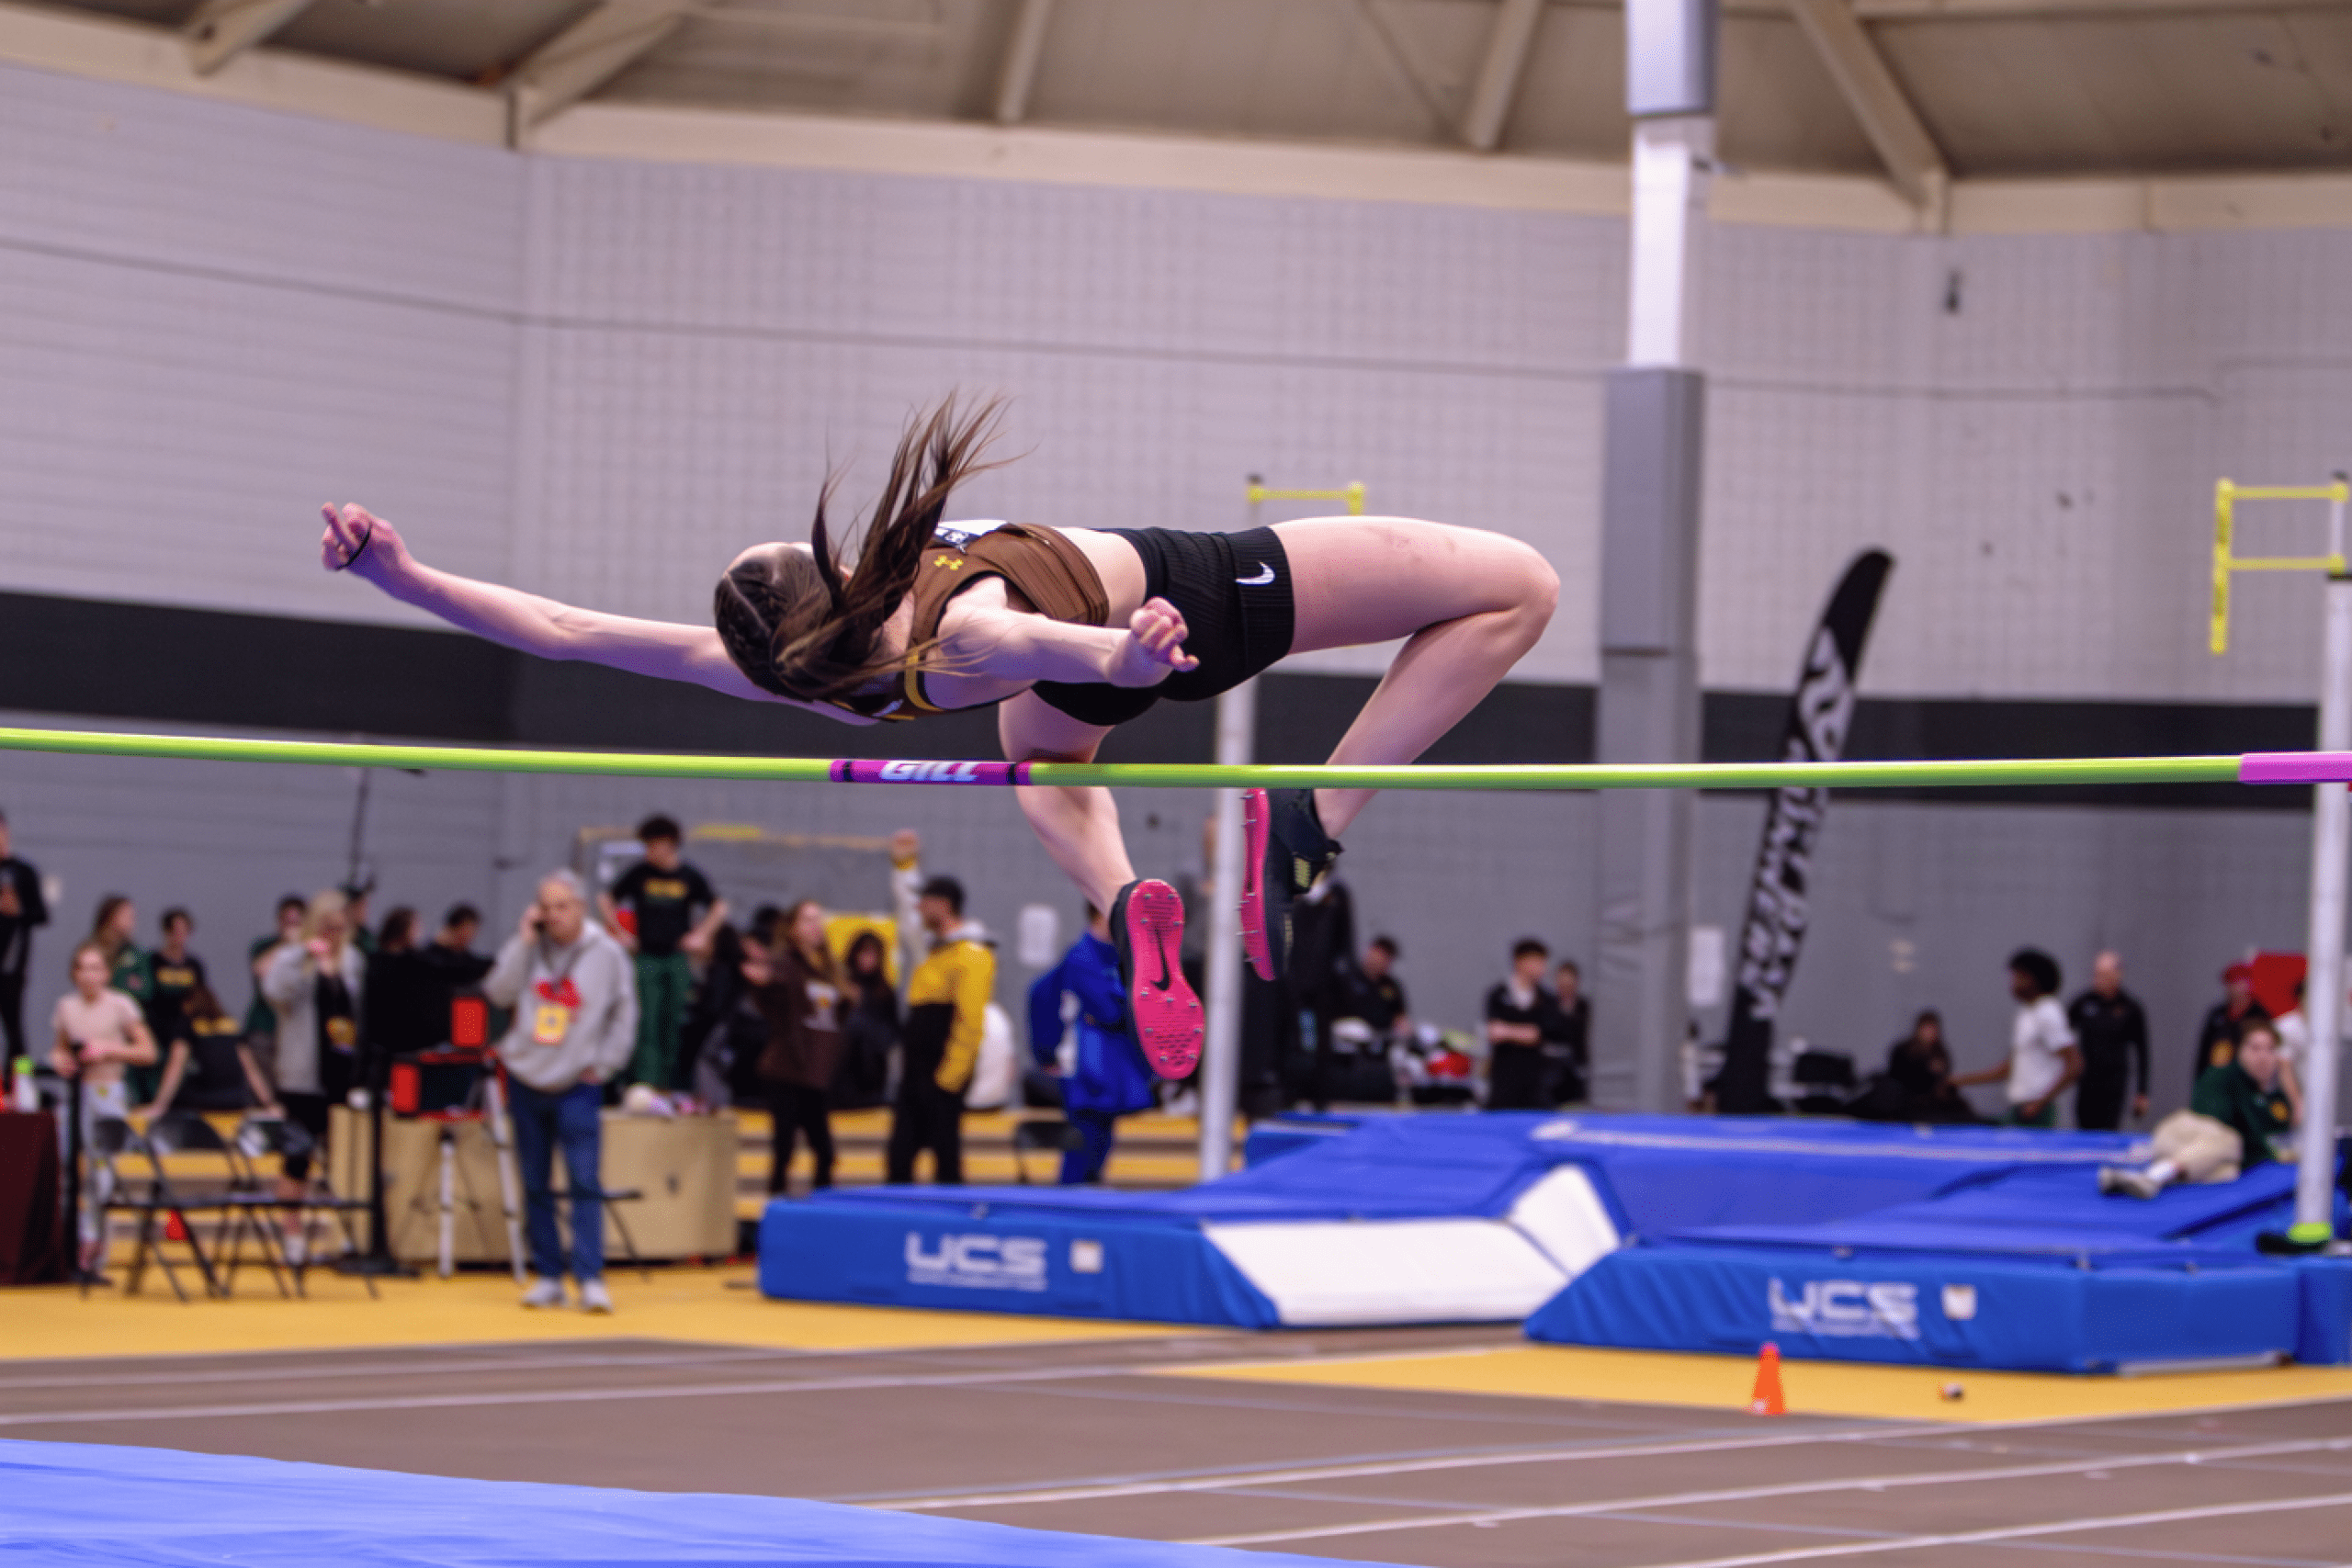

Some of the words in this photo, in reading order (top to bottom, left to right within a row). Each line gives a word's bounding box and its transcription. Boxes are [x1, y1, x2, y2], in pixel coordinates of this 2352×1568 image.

[879, 760, 978, 782] GILL
[905, 1231, 1047, 1275] UCS
[1768, 1276, 1918, 1325] UCS
